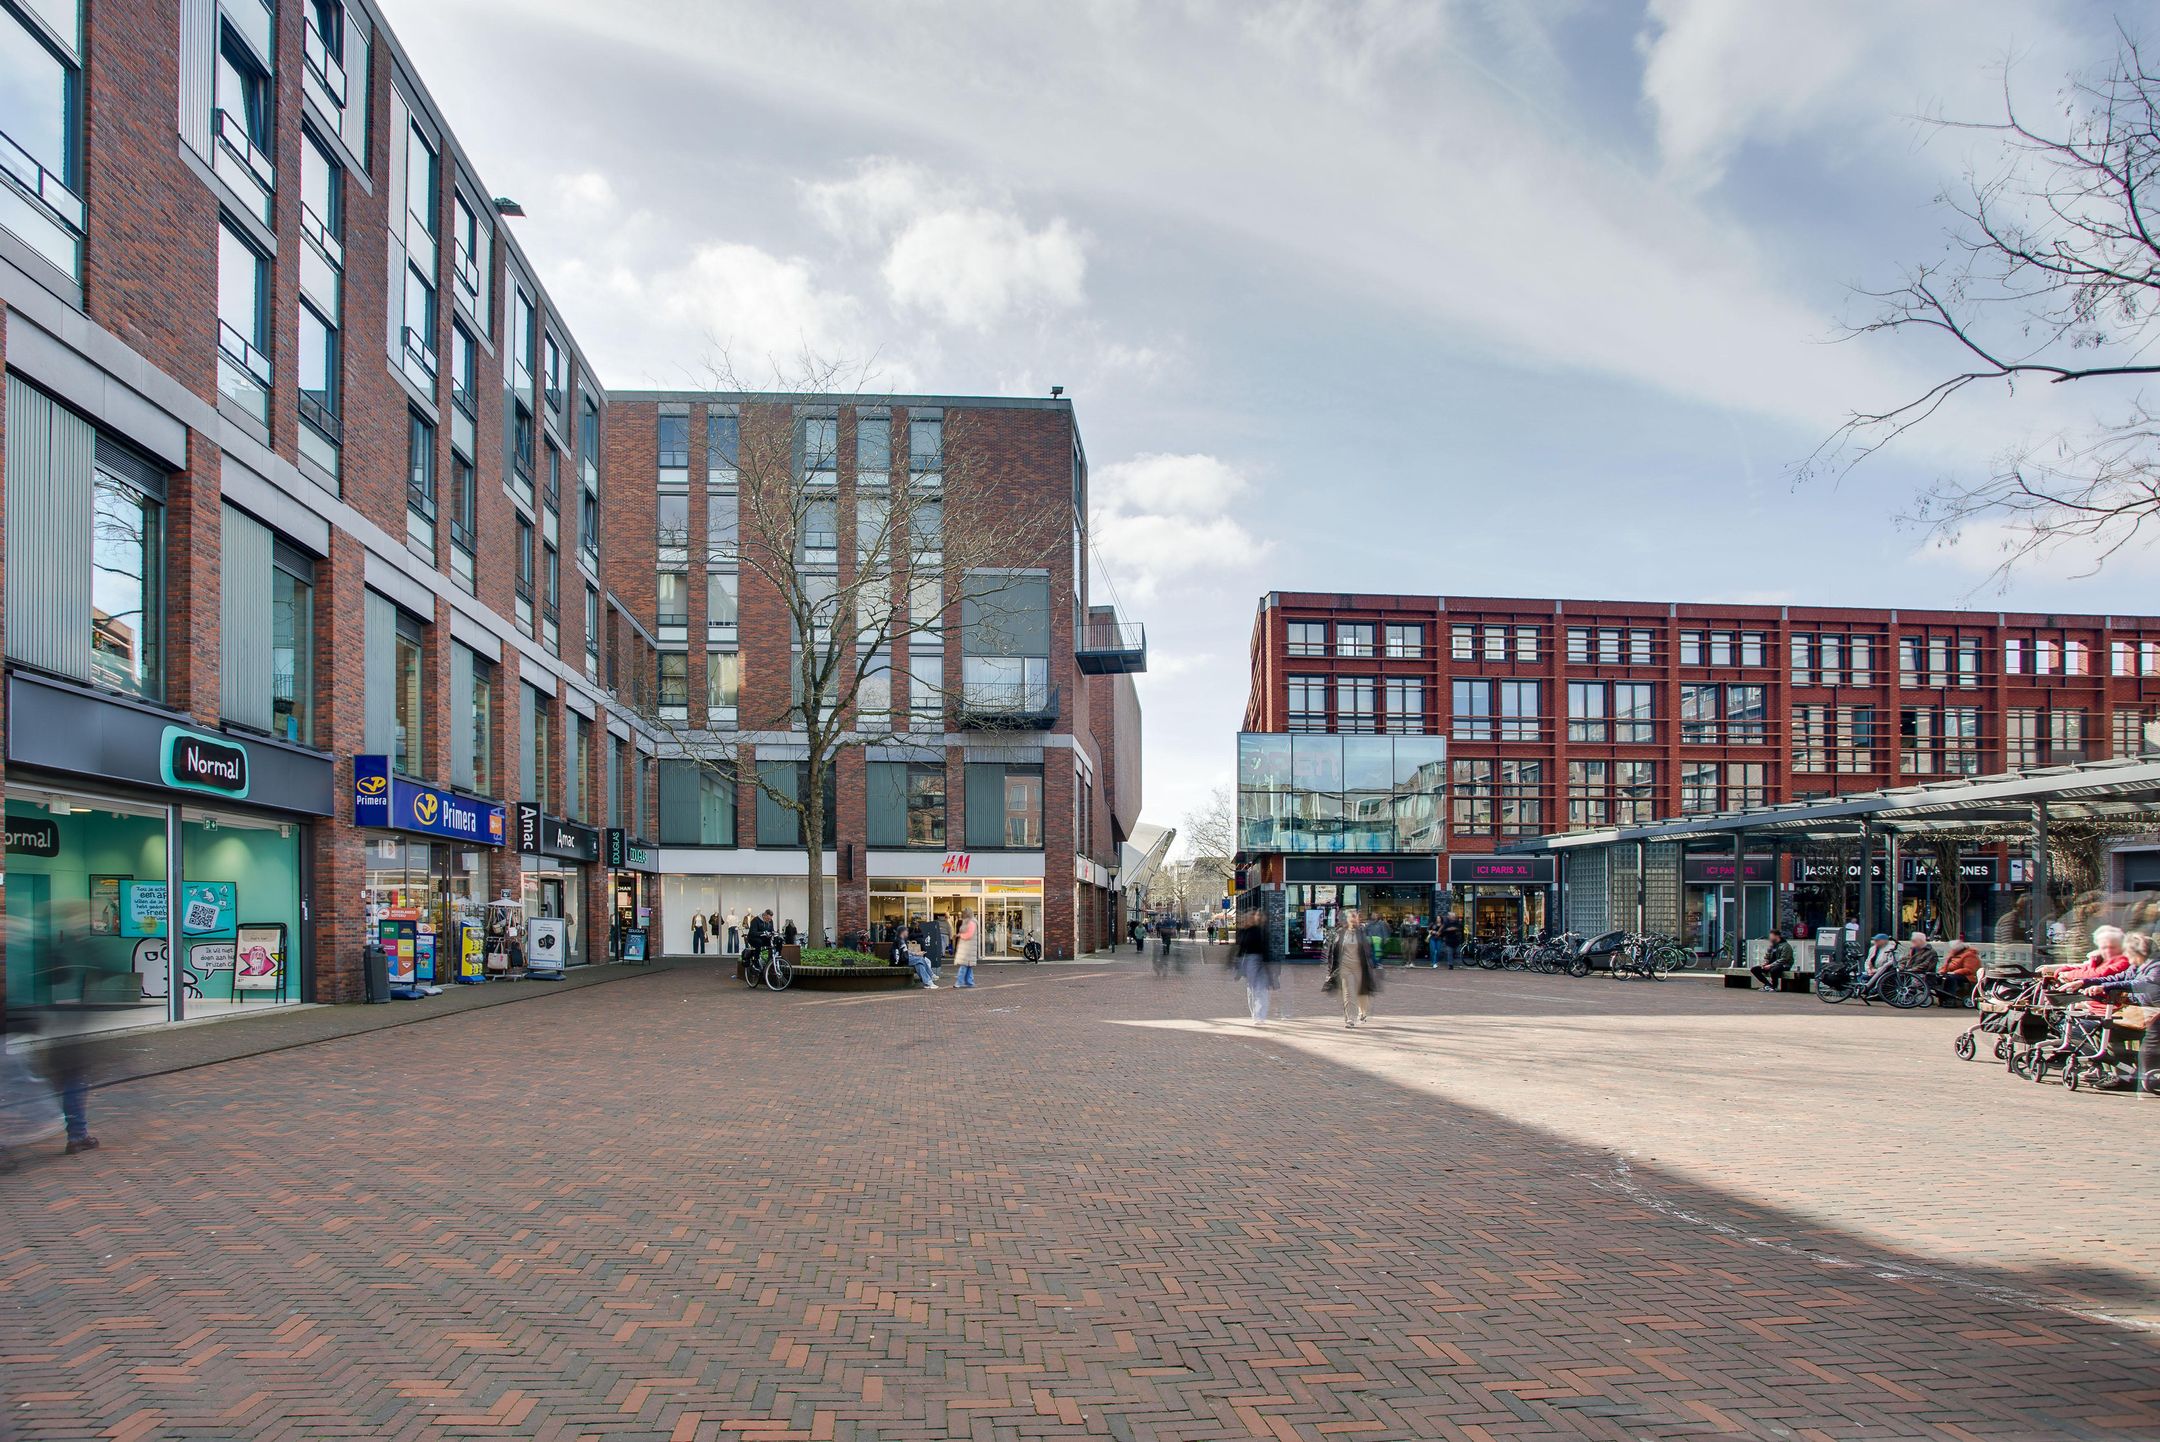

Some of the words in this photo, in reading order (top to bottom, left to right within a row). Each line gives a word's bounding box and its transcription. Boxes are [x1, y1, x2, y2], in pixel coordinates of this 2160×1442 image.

[188, 746, 239, 780] Normal
[356, 795, 387, 805] Primera
[443, 800, 476, 832] Primera
[521, 805, 537, 850] Amac
[5, 828, 50, 848] ormal
[557, 828, 575, 848] Amac
[1336, 866, 1348, 874] ICI
[1350, 866, 1373, 874] PARIS
[1377, 866, 1387, 874] XL
[1477, 866, 1488, 874] ICI
[1491, 866, 1514, 874] PARIS
[1517, 866, 1527, 874] XL
[1707, 866, 1718, 874] ICI
[1720, 866, 1735, 874] PAR
[1959, 866, 1988, 875] ONES
